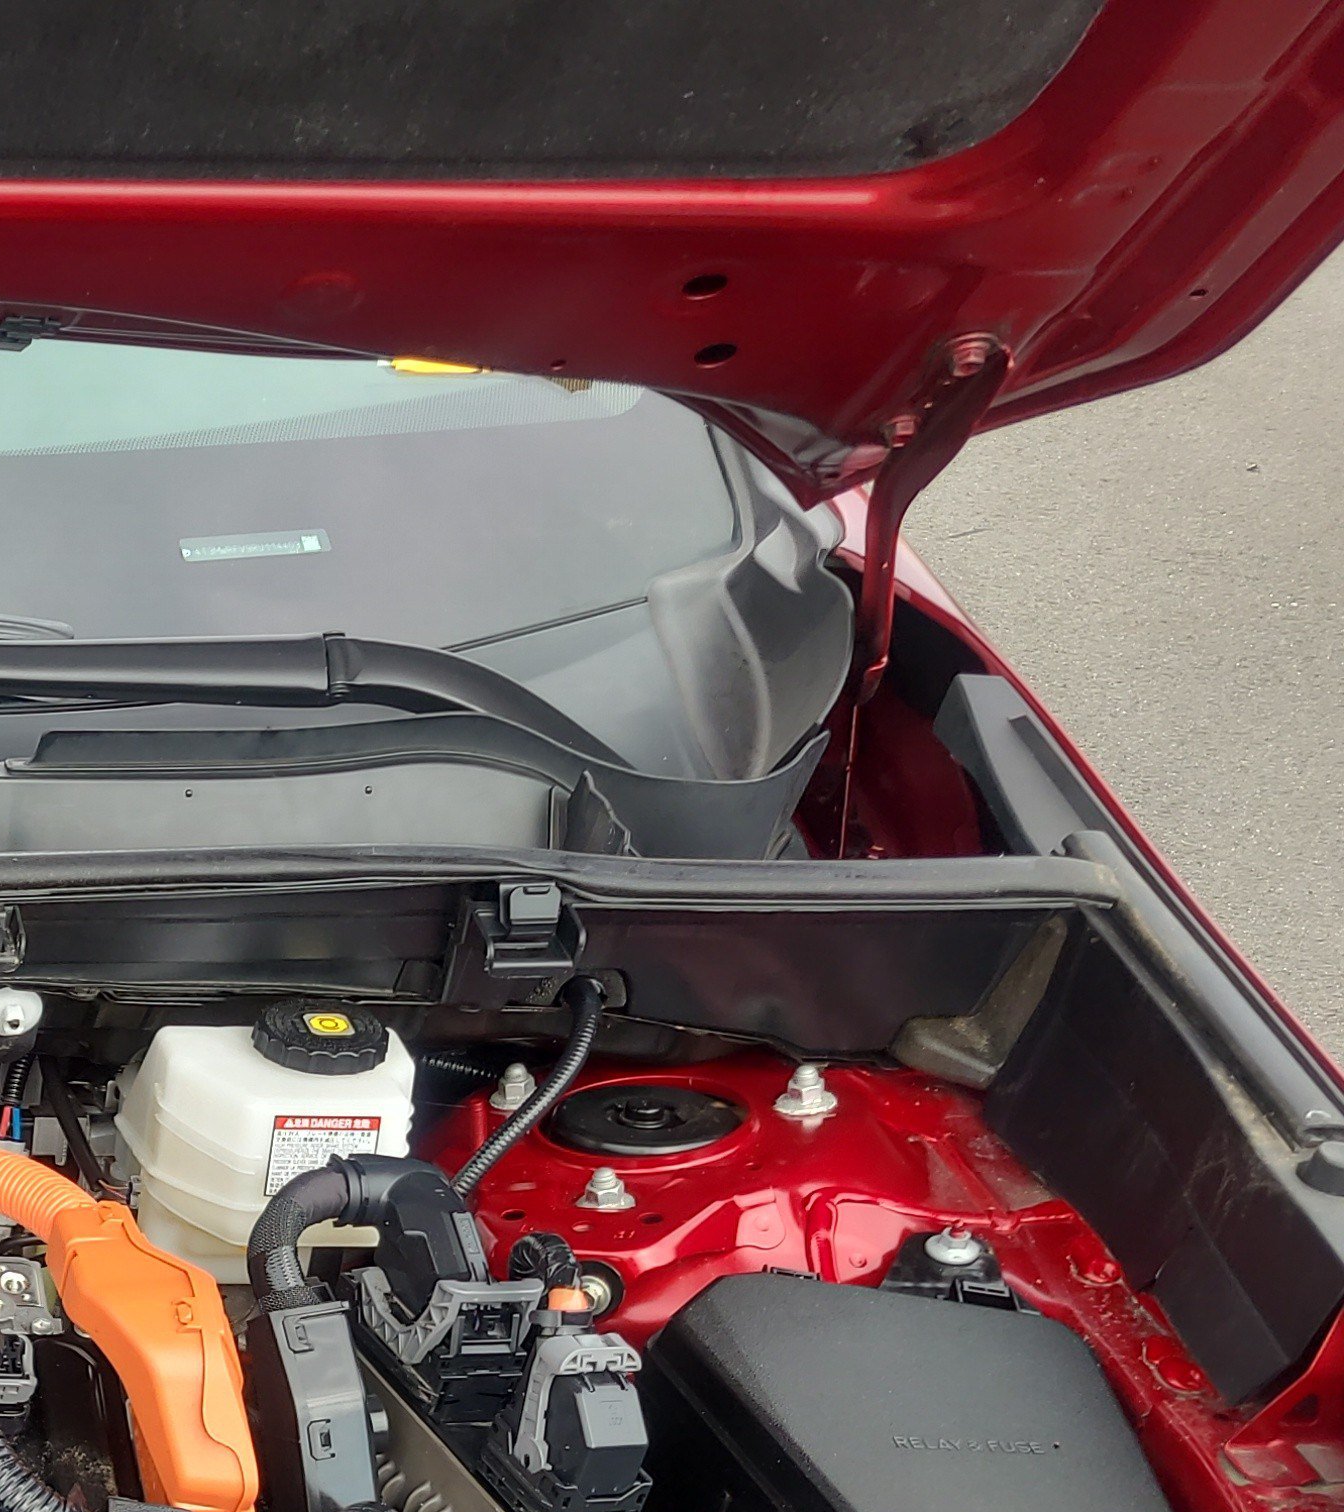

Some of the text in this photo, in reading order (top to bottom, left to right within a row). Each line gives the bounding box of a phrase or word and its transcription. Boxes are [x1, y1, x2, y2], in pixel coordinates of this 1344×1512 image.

[311, 1118, 352, 1128] DANGER
[893, 1435, 962, 1450] RELAY
[986, 1439, 1045, 1455] FUSE
